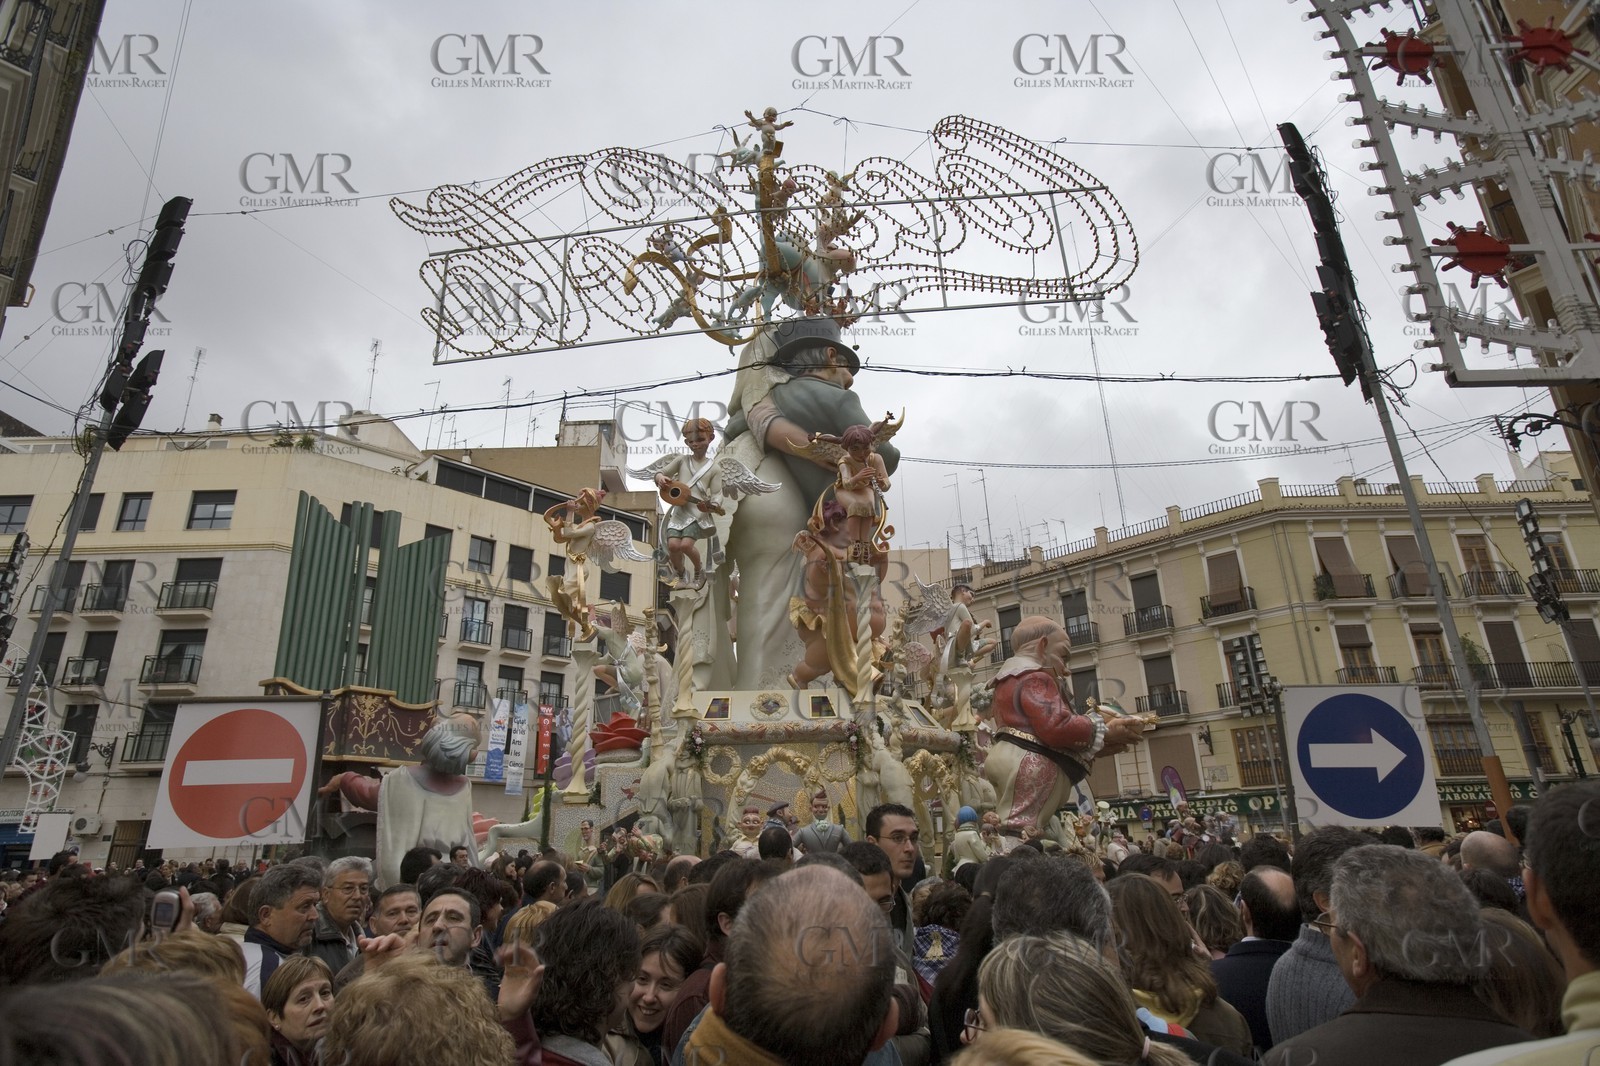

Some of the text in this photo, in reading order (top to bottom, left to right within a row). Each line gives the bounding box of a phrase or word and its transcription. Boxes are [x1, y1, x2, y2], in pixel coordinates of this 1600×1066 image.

[1437, 783, 1520, 793] ORTOPEA
[1438, 791, 1522, 801] LABORATIO
[1147, 798, 1237, 811] ORTPEDIA
